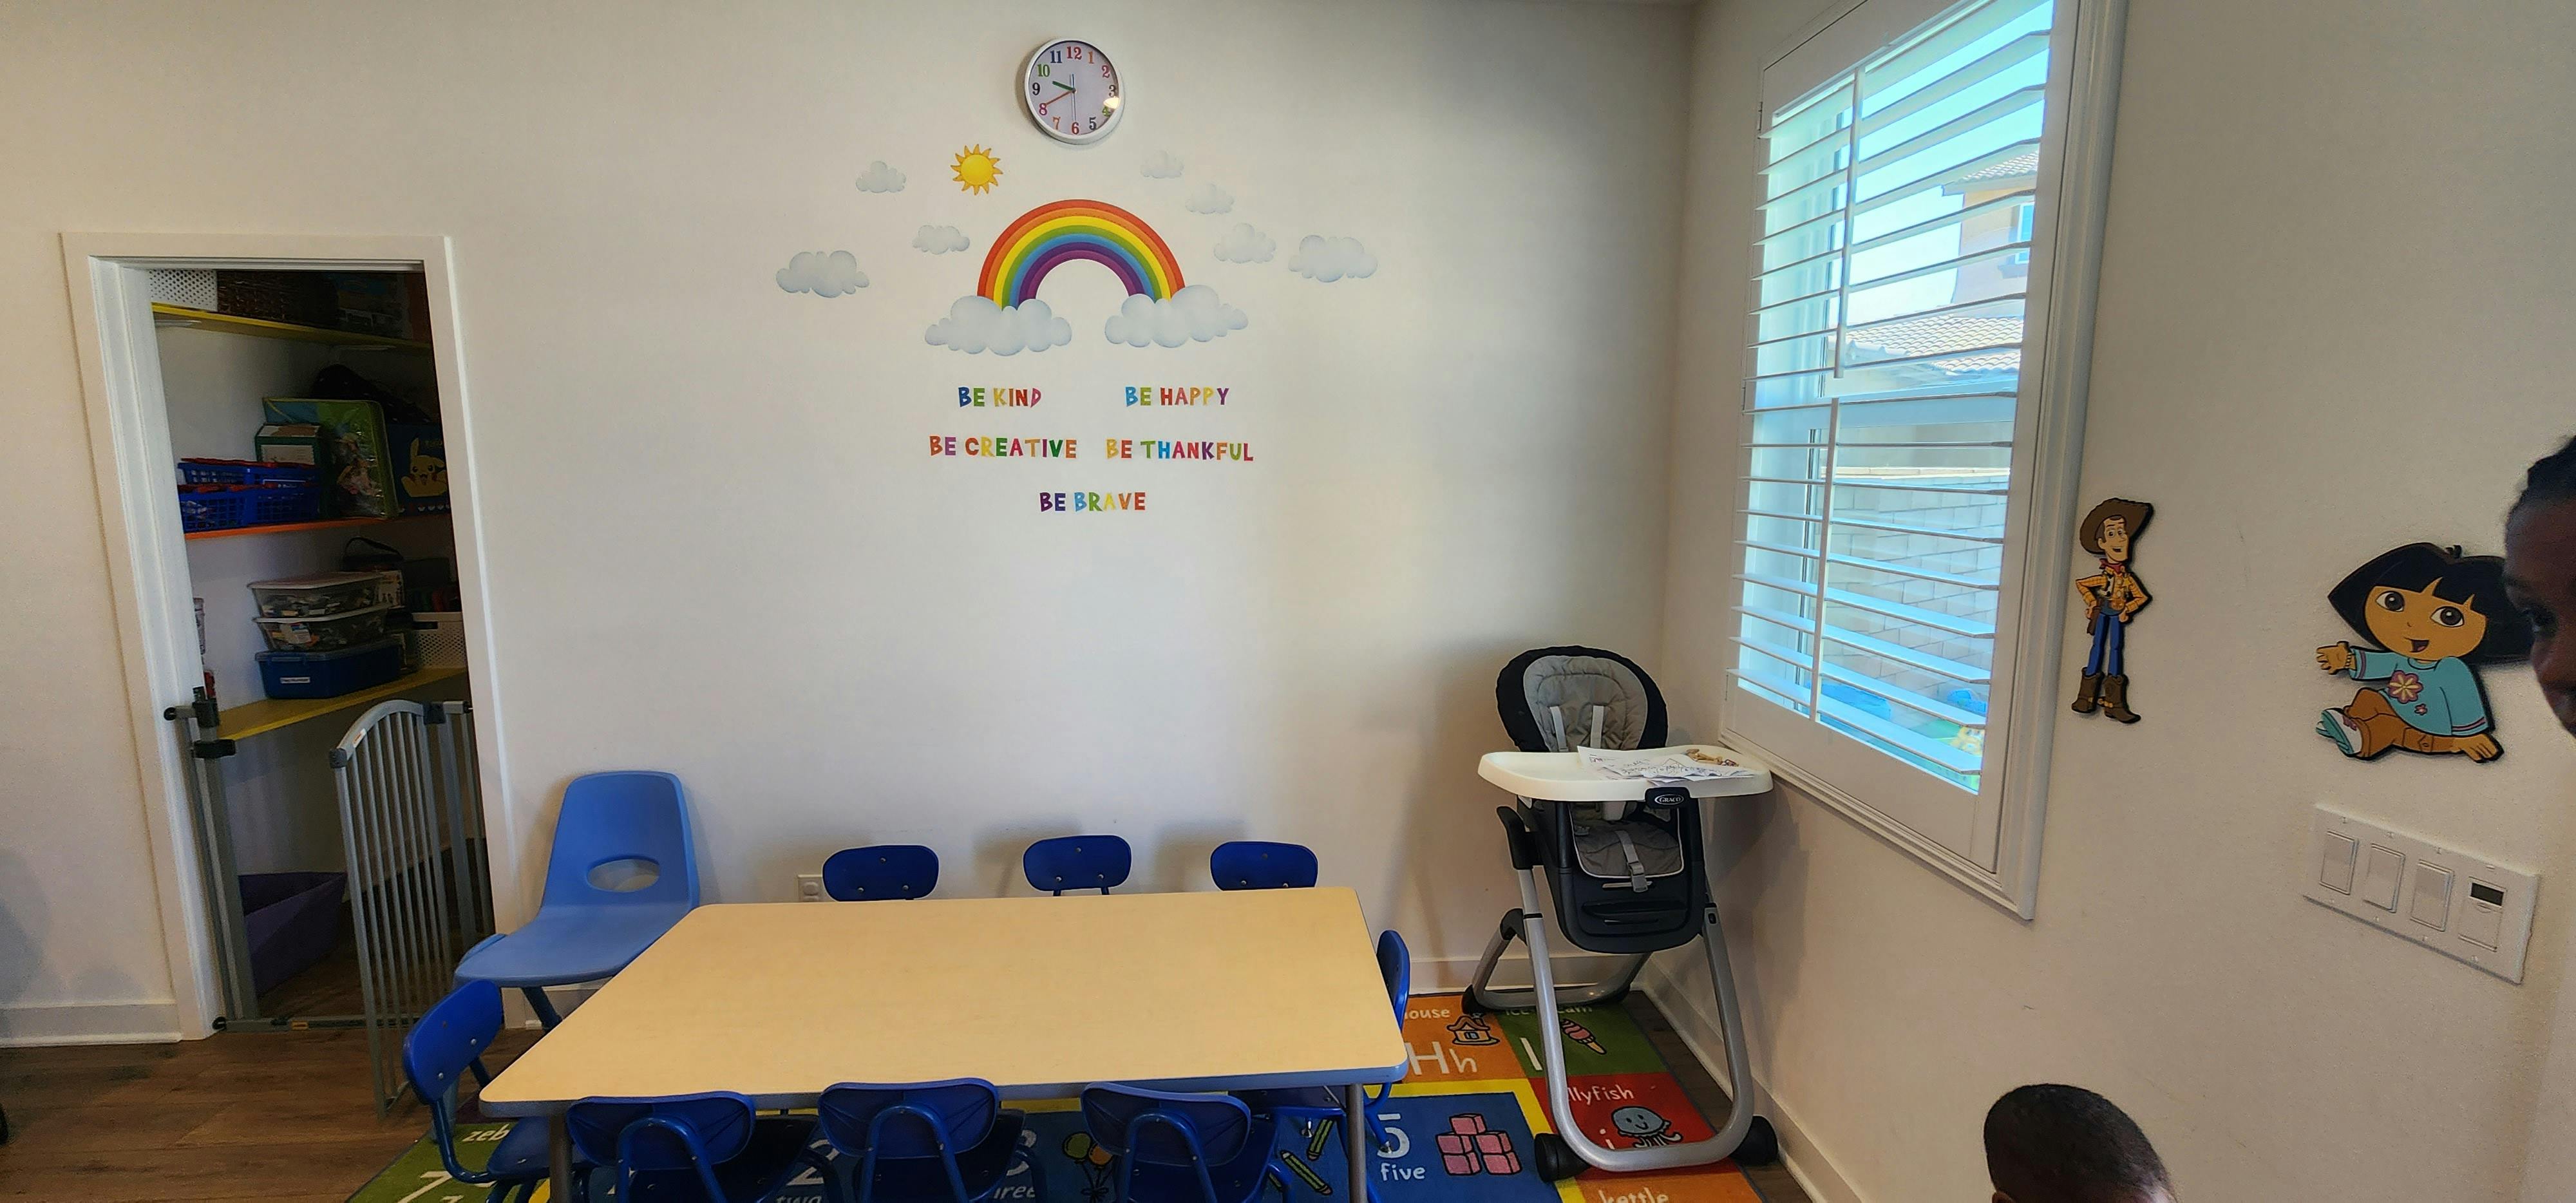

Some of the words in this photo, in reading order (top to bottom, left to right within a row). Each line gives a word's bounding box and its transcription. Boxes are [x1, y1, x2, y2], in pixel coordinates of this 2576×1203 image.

[1050, 50, 1063, 64] 11
[1066, 46, 1083, 60] 12
[1088, 51, 1095, 64] 1
[1037, 64, 1050, 77] 10
[1101, 65, 1110, 78] 2
[1032, 82, 1041, 95] 9
[1108, 84, 1116, 97] 3
[1039, 102, 1048, 116] 8
[1052, 116, 1061, 129] 7
[1071, 122, 1080, 135] 6
[1088, 117, 1097, 130] 5
[958, 386, 985, 408] BE
[992, 387, 1041, 408] KIND
[1125, 386, 1152, 407] BE
[1160, 386, 1229, 406] HAPPY
[929, 435, 957, 457] BE
[965, 436, 1077, 459] CREATIVE
[1106, 438, 1133, 459] BE
[1140, 440, 1254, 462] THANKFUL
[1039, 491, 1066, 513] BE
[1074, 491, 1146, 513] BRAVE
[1567, 1085, 1634, 1106] llyfish
[1377, 1113, 1410, 1159] 5
[1380, 1162, 1426, 1181] five
